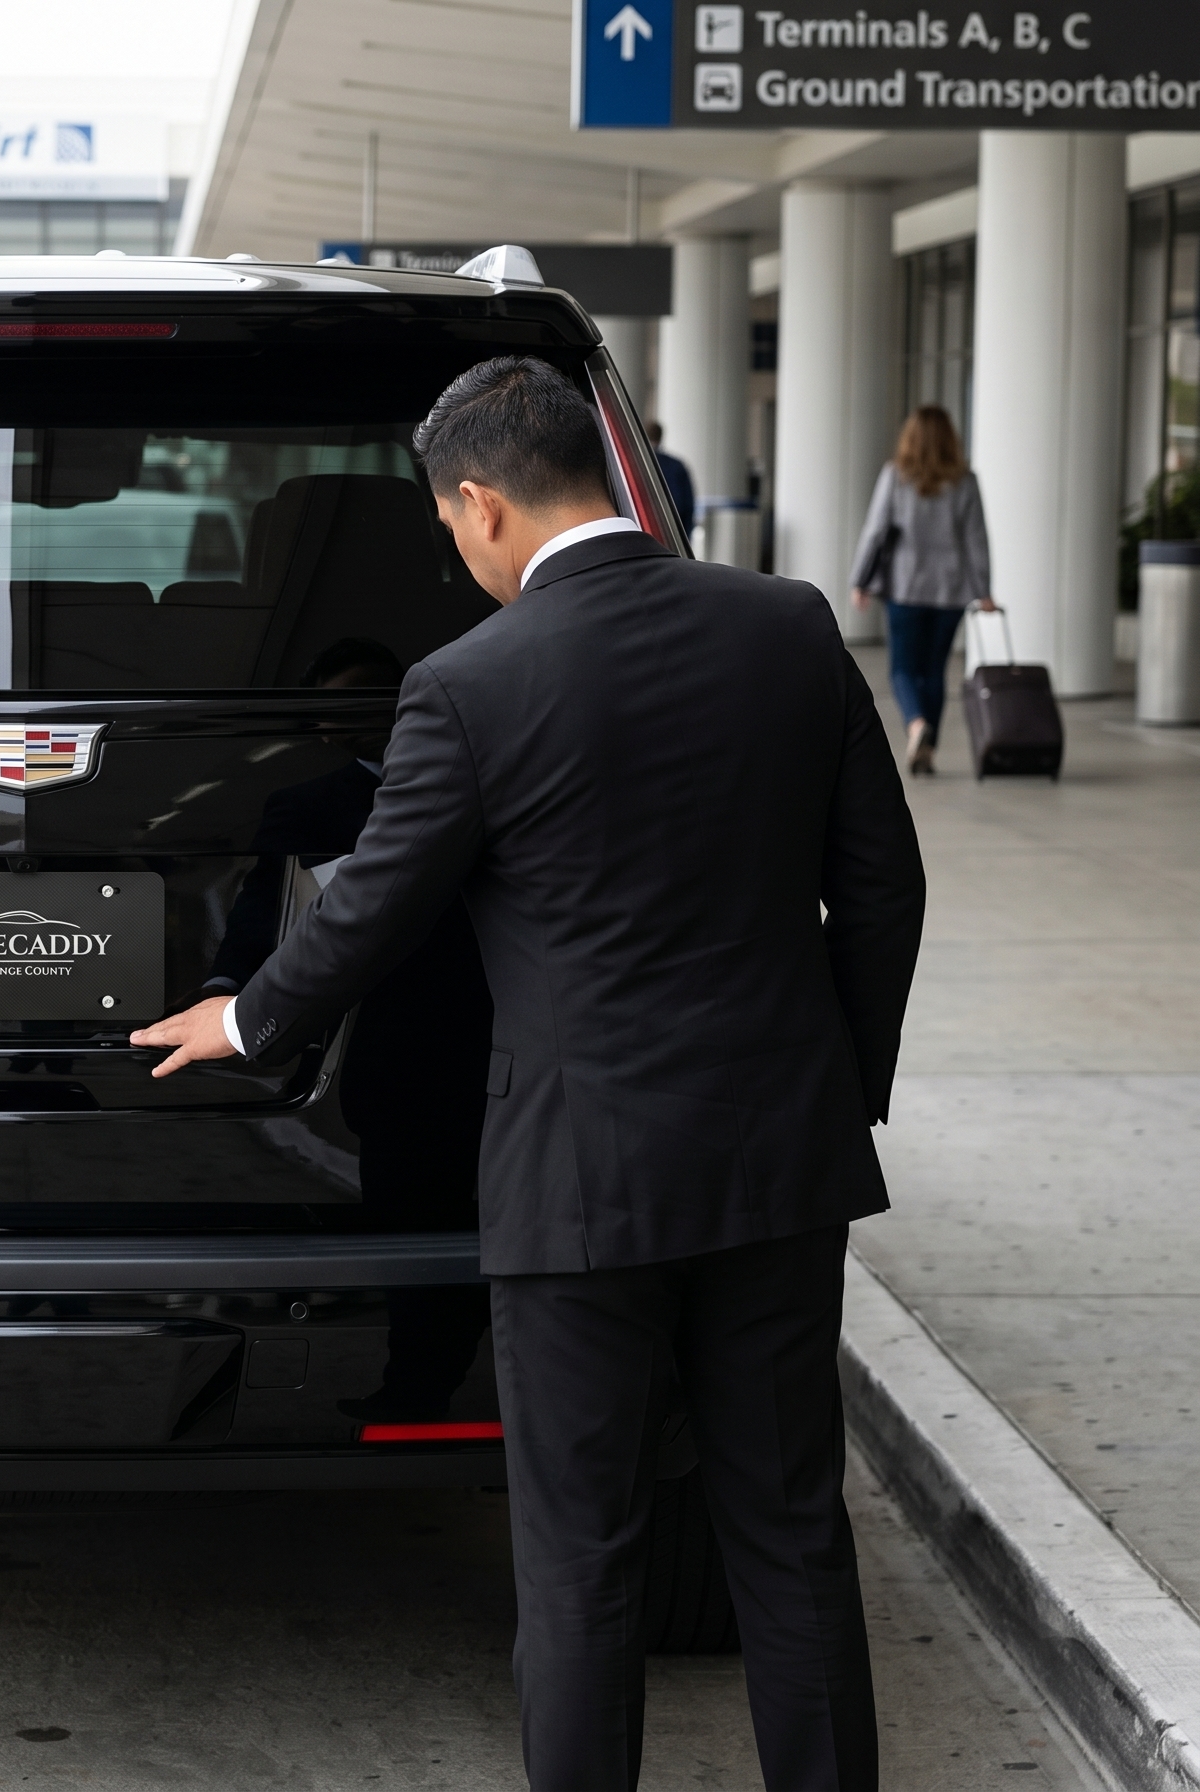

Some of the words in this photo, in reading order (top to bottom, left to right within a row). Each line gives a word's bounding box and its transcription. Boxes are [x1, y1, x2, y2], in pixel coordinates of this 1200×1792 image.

[756, 10, 948, 49] Terminals
[959, 13, 1000, 52] A,
[1014, 13, 1050, 53] B,
[1063, 13, 1091, 49] C
[756, 69, 906, 107] Ground
